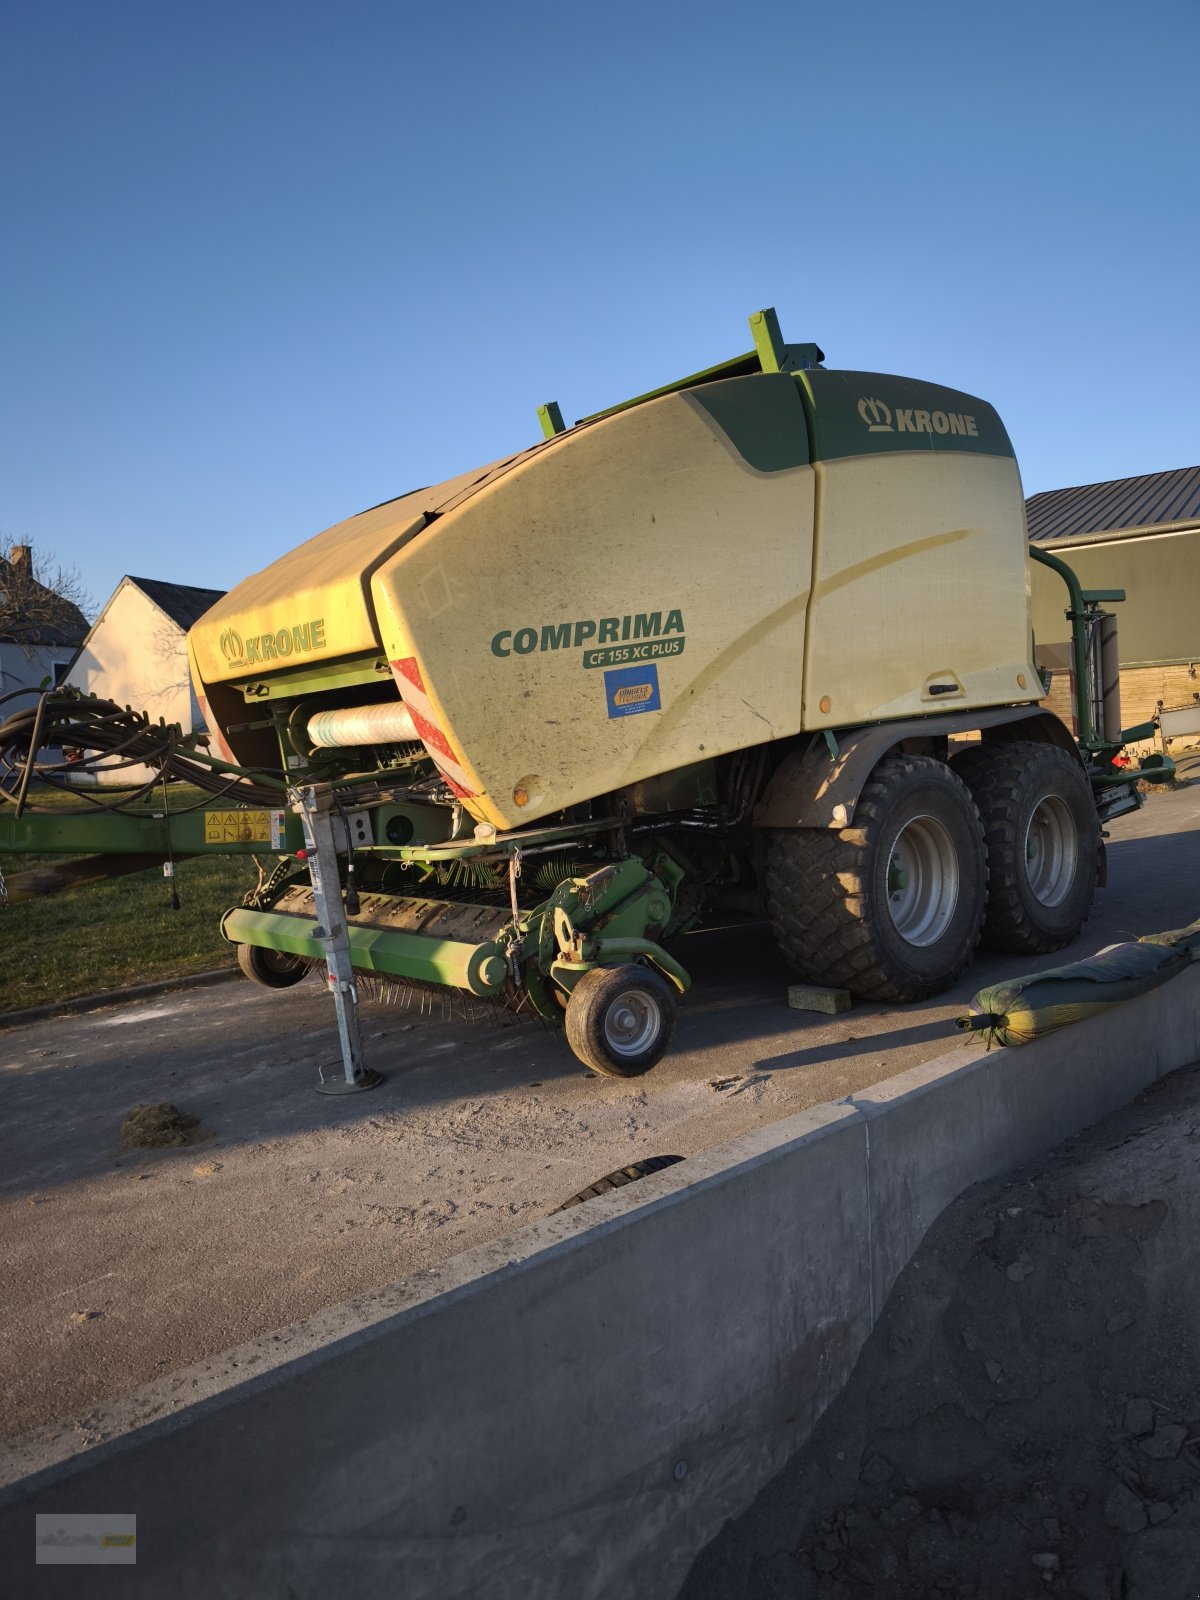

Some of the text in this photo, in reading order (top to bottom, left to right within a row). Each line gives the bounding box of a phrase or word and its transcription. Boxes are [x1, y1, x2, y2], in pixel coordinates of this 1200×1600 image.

[895, 408, 978, 436] KRONE
[245, 618, 326, 664] KRONE
[490, 608, 685, 658] COMPRIMA
[589, 641, 679, 665] CF 155 XC PLUS
